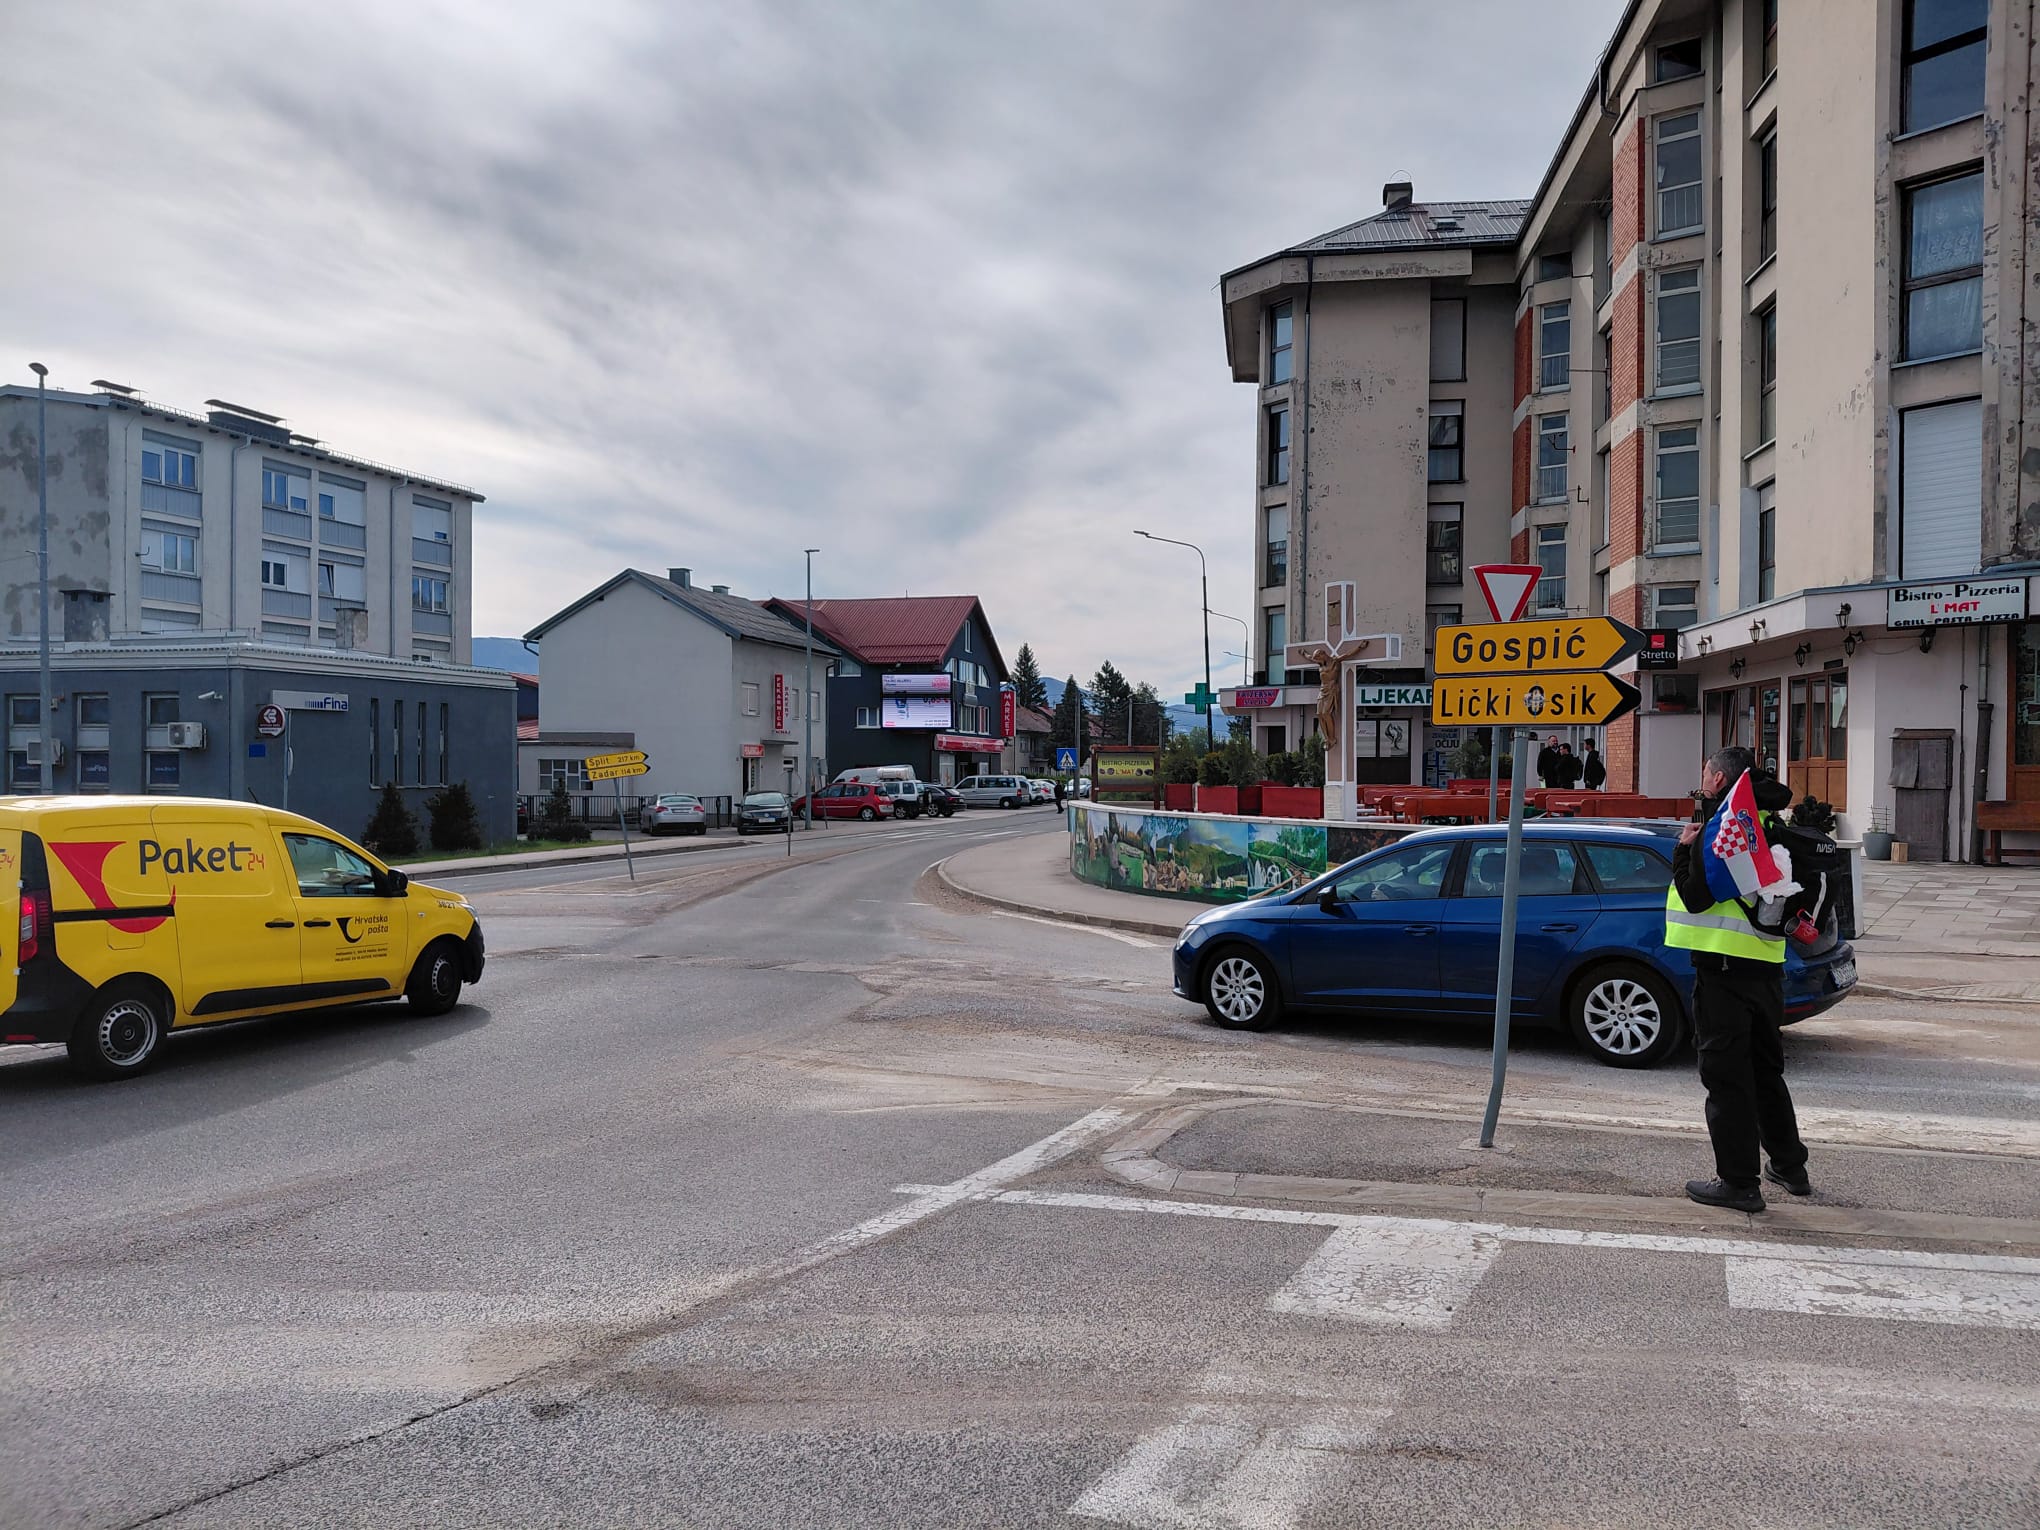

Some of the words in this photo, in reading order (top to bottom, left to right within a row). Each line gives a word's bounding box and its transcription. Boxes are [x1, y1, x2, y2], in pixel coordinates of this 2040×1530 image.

[1944, 601, 1980, 613] MAT
[1452, 627, 1586, 668] Gospić
[1640, 650, 1676, 660] Stretto
[323, 696, 348, 709] Fina
[1440, 687, 1511, 717] Lički
[1527, 685, 1597, 716] Osik
[1003, 693, 1011, 736] MARKET
[588, 757, 609, 767] Split
[617, 755, 628, 763] 217
[592, 769, 618, 779] Zadar
[139, 838, 252, 875] Paket
[354, 914, 389, 924] Hrvatska
[367, 925, 389, 936] pošta
